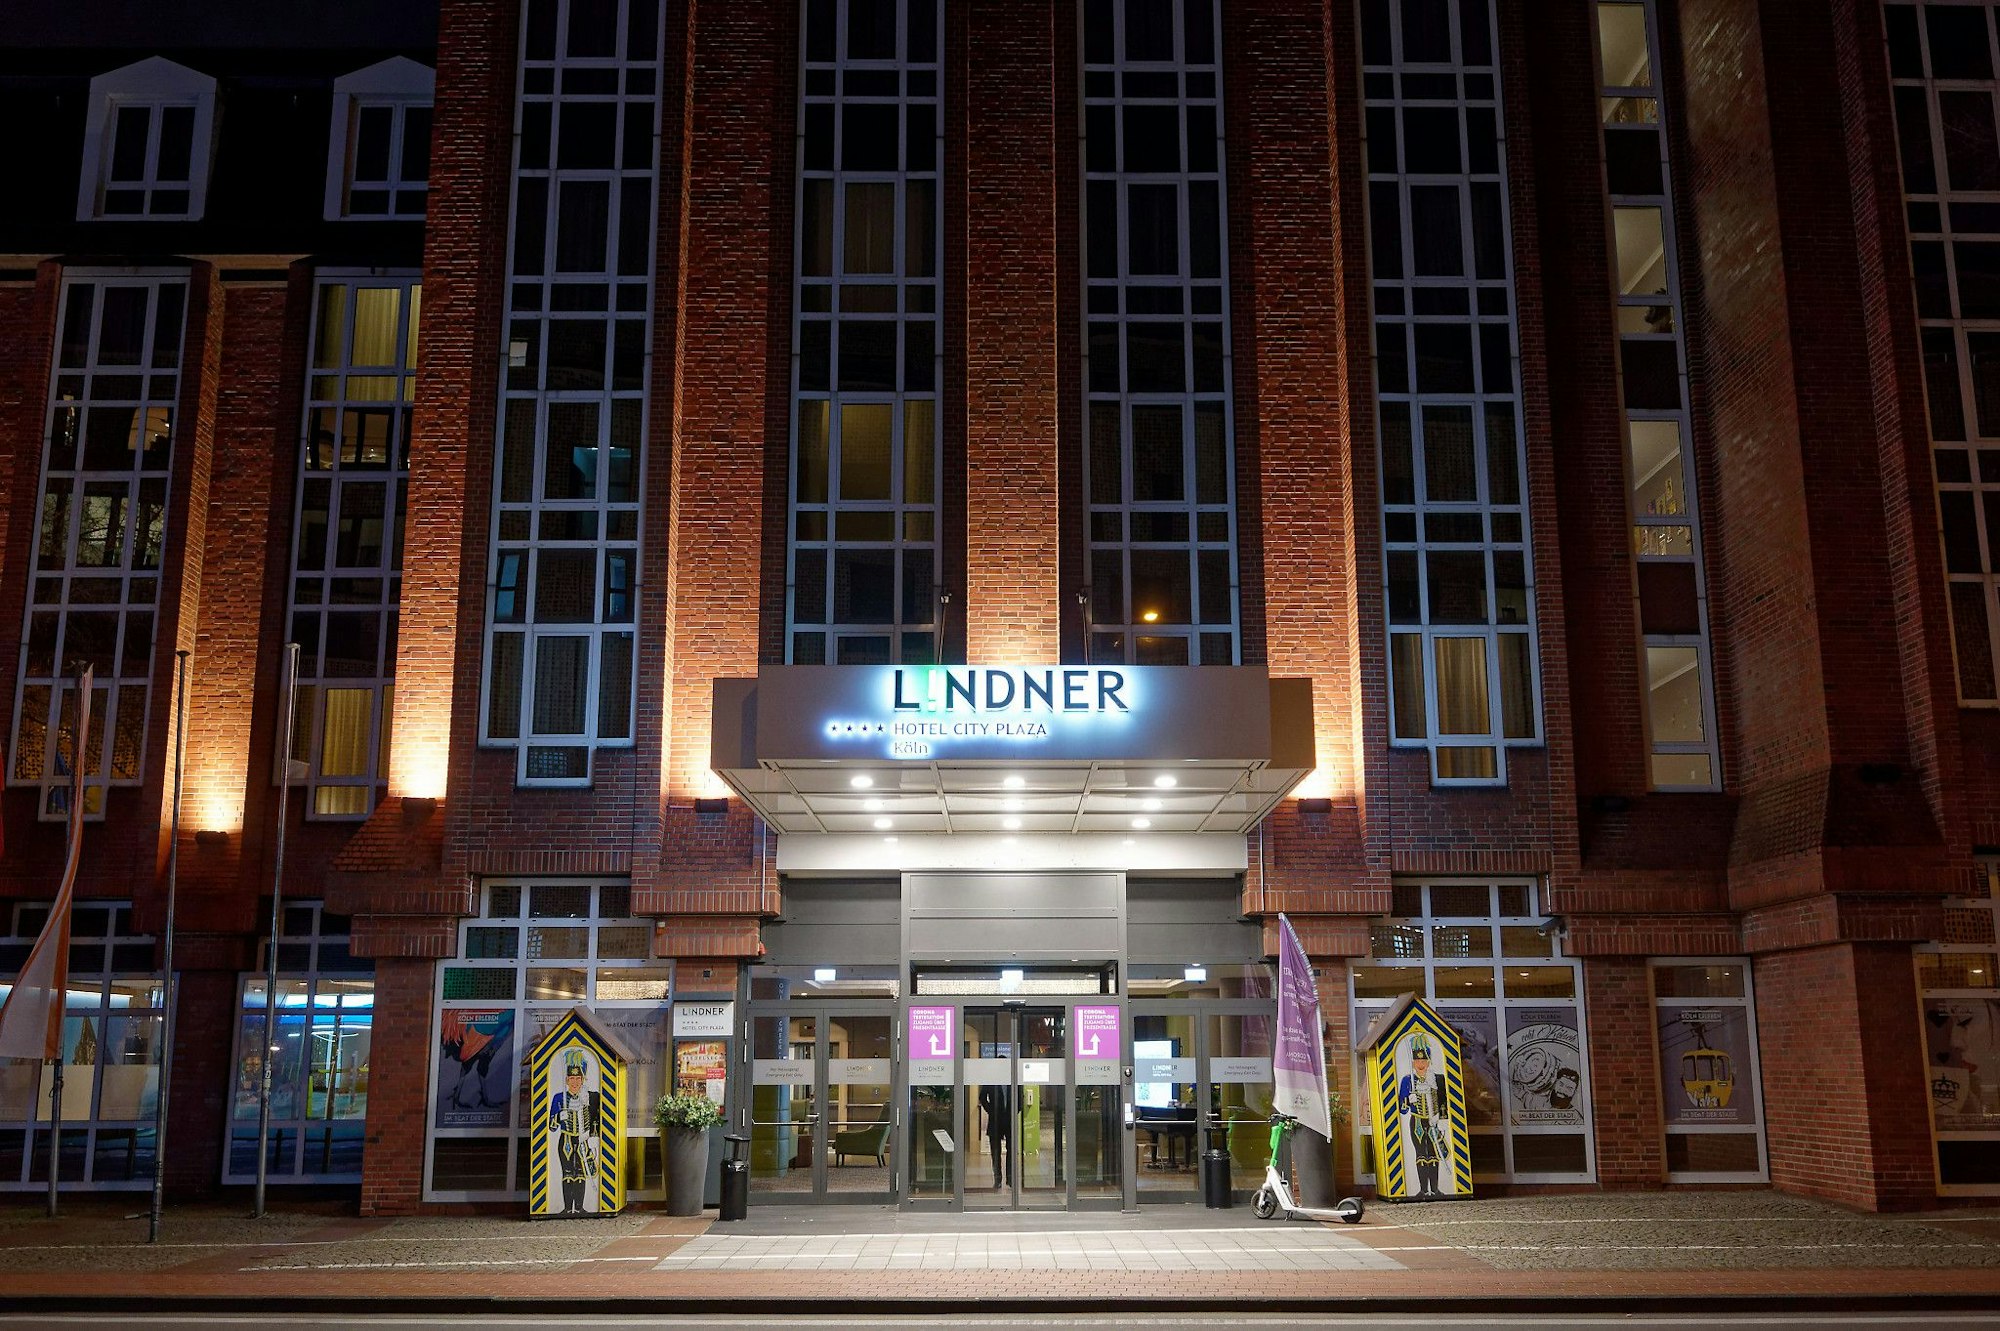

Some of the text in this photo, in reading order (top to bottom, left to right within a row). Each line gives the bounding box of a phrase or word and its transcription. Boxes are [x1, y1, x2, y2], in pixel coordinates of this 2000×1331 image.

[894, 722, 1047, 736] HOTEL CITY PLAZA
[894, 741, 928, 755] Köln
[682, 1008, 724, 1016] LINDNER
[458, 1014, 474, 1022] KÖLN
